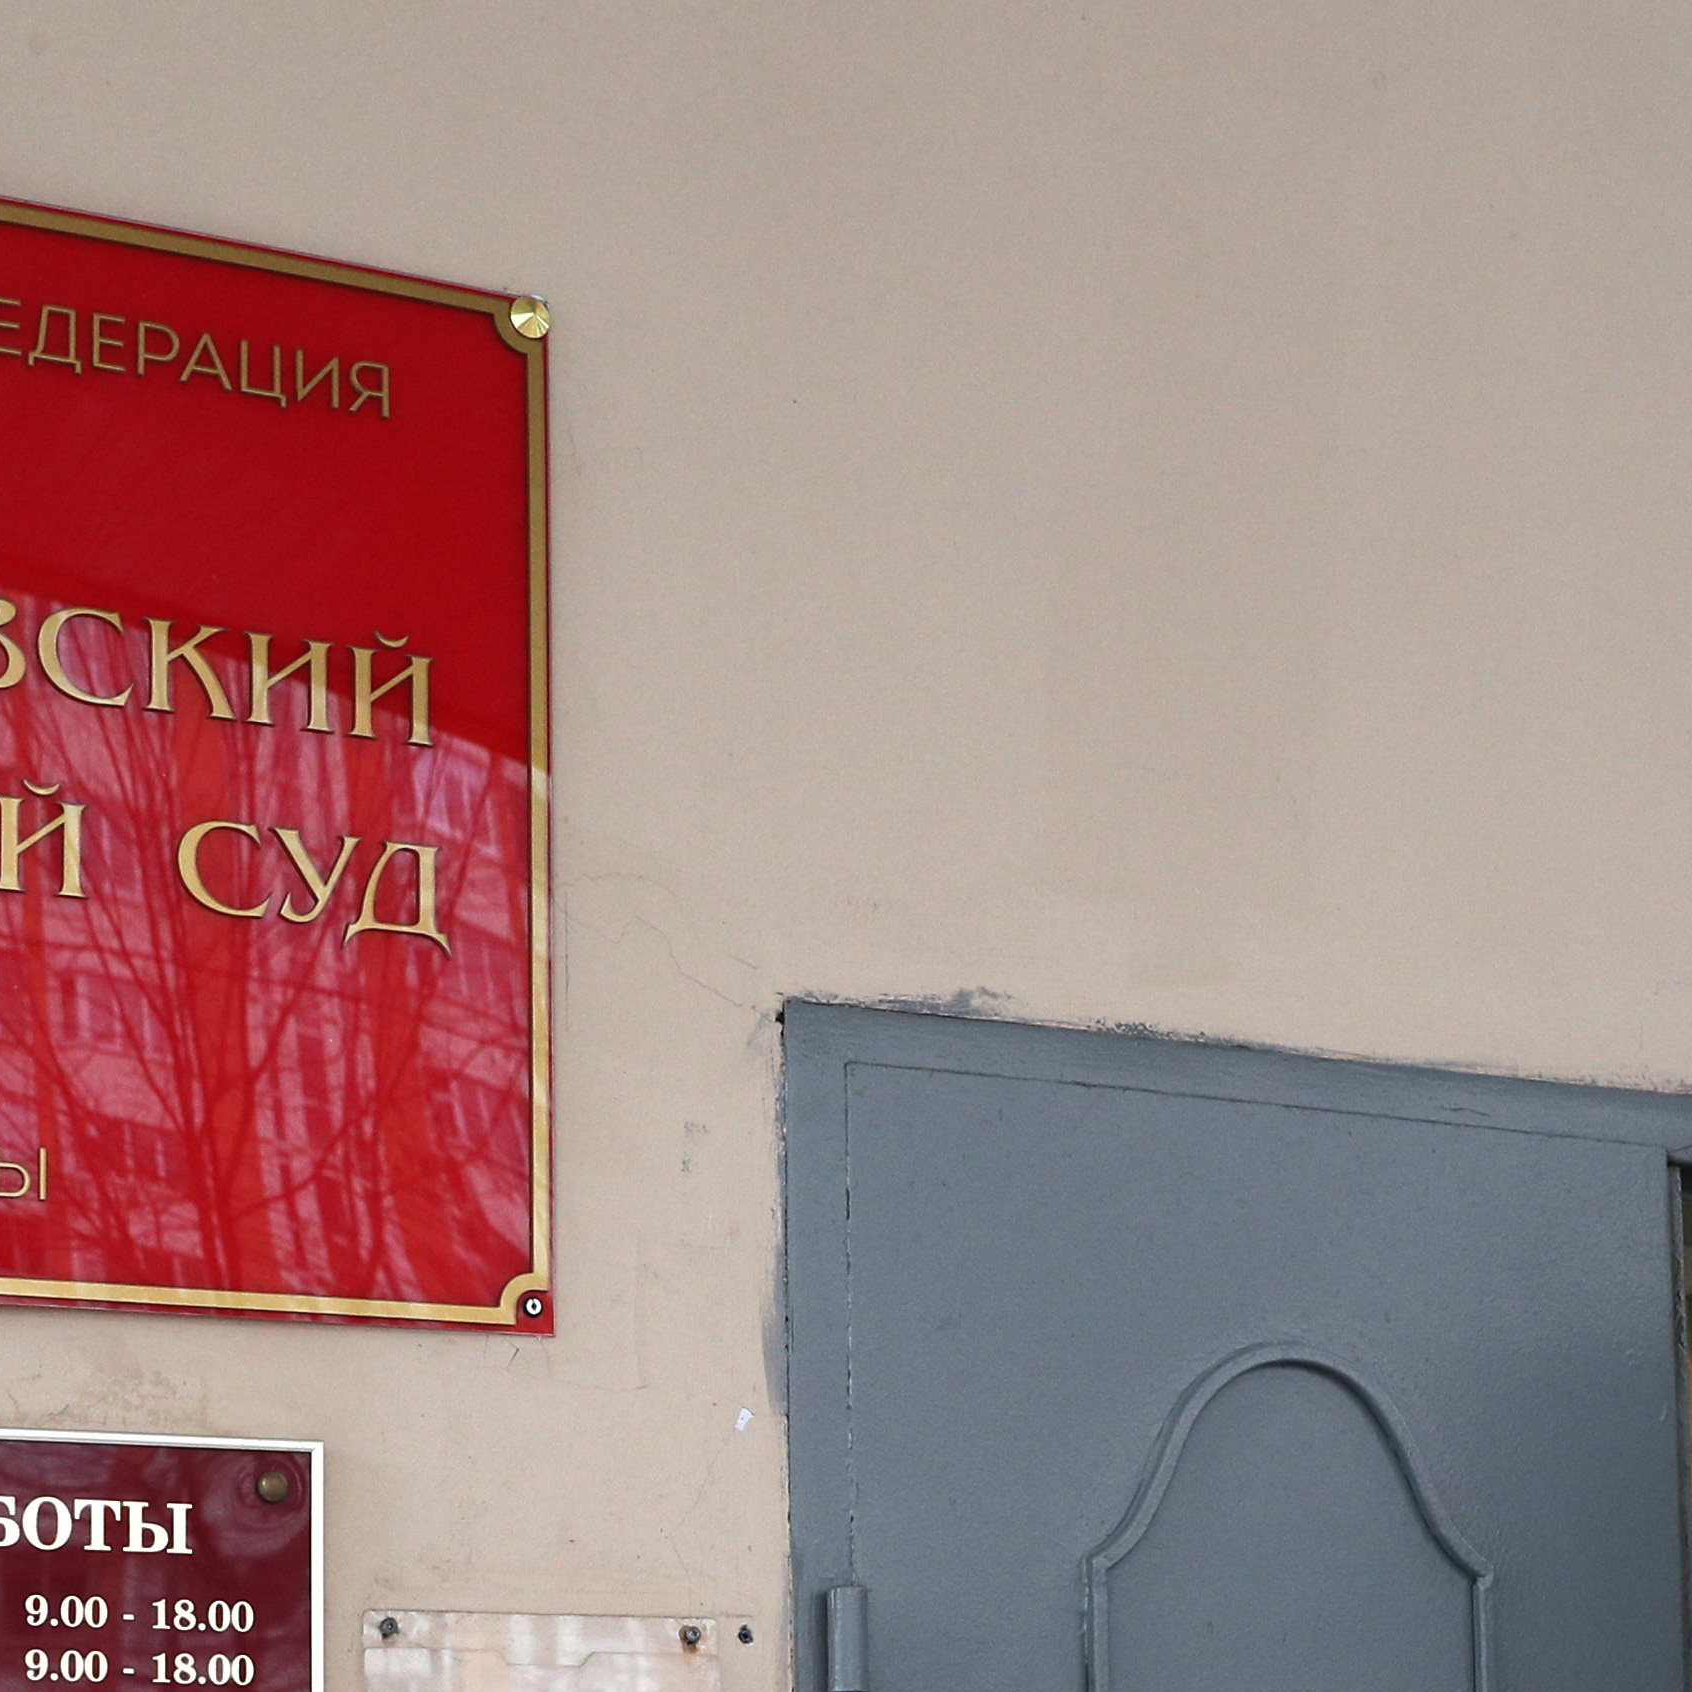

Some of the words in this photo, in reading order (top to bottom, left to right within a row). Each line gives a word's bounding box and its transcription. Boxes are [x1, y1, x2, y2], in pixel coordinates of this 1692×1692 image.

[176, 819, 452, 957] СУД
[24, 1594, 108, 1629] 9.00
[151, 1598, 254, 1633] 18.00
[24, 1648, 109, 1683] 9.00
[152, 1652, 255, 1686] 18.00
